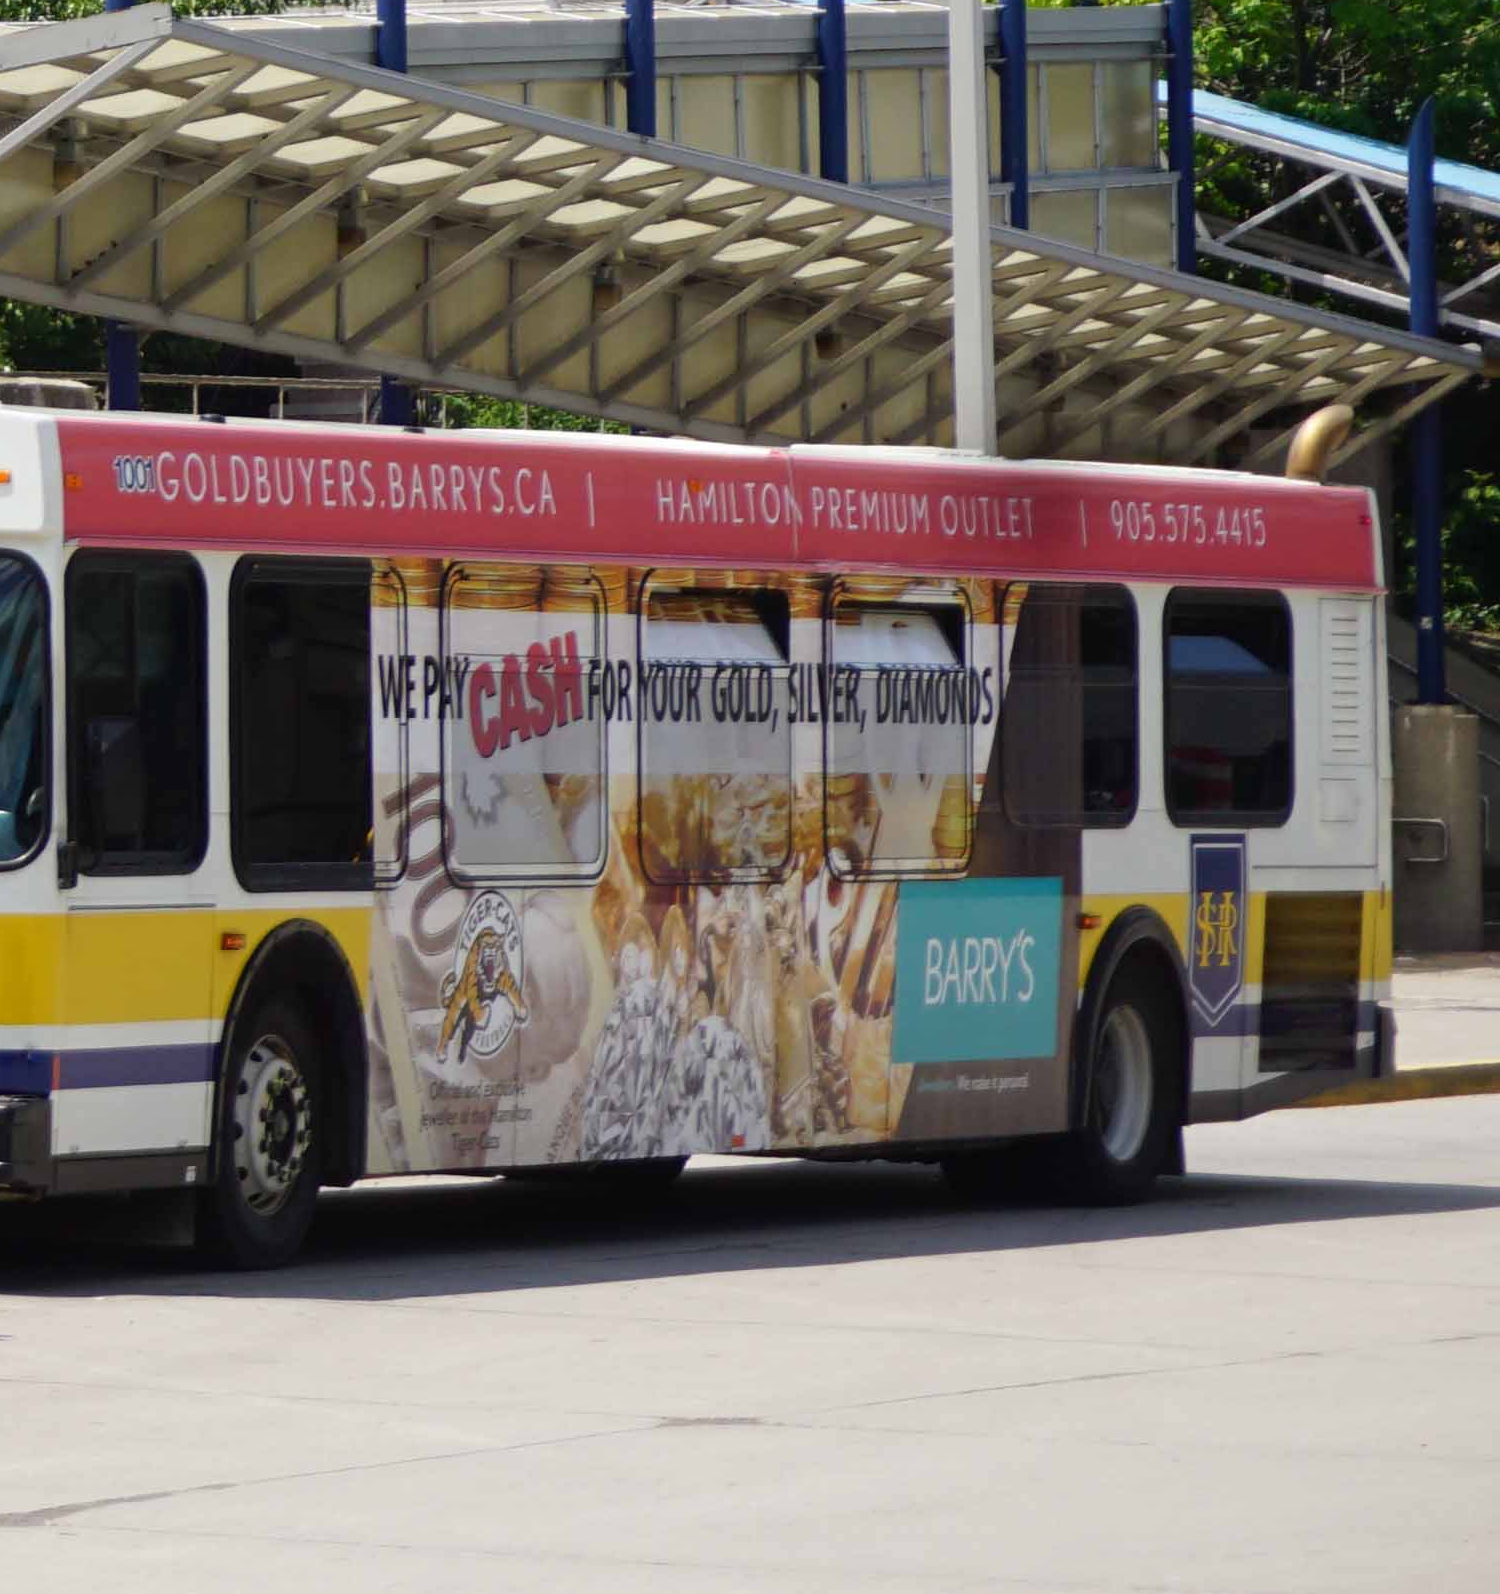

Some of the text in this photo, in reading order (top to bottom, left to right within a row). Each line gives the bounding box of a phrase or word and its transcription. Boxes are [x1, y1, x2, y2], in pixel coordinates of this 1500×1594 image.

[113, 457, 156, 493] 1001
[156, 451, 1268, 548] GOLDBUYERS.BARRYS.CA HAMILTON PREMIUM OUTLET 905.575.4415
[378, 653, 416, 720] WE
[423, 656, 469, 721] PAY
[467, 629, 584, 759] CASH
[587, 659, 632, 722] FOR
[637, 658, 701, 724] YOUR
[711, 662, 779, 733] GOLD,
[876, 663, 994, 728] DIAMONDS
[460, 897, 520, 953] TIGER-CATS
[924, 926, 1036, 1006] BARRY'S
